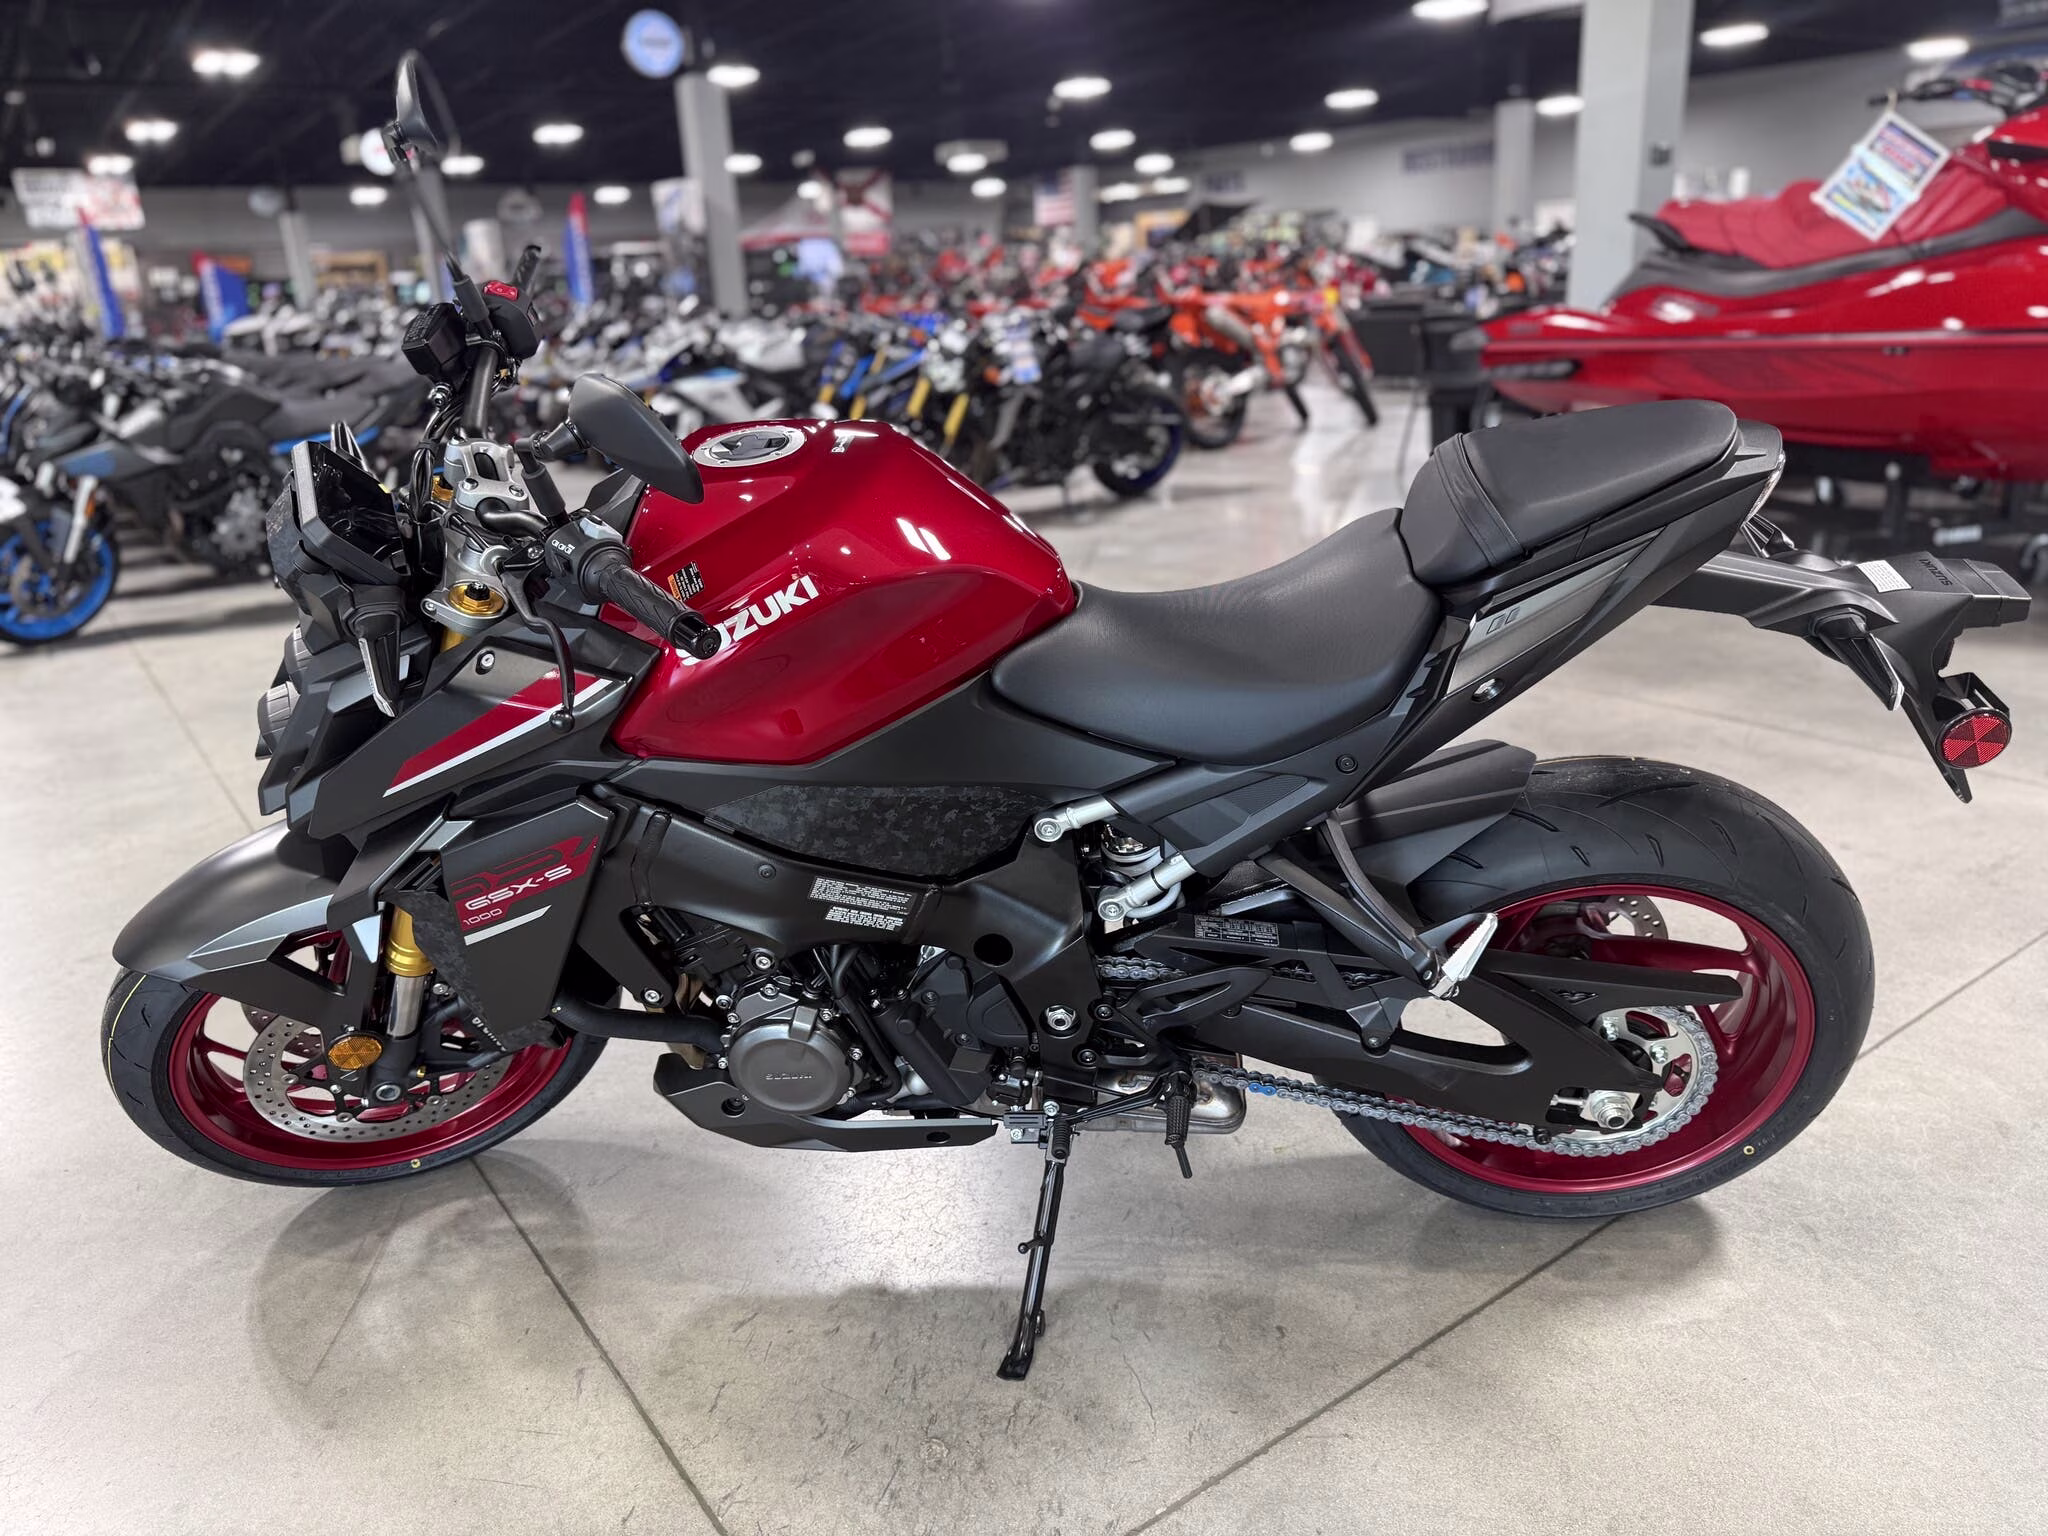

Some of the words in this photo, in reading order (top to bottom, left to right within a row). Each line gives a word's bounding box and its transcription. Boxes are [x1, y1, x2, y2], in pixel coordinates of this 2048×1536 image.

[1919, 559, 1953, 586] SUZUKI
[465, 864, 572, 911] GSX-S
[463, 908, 503, 926] 1000
